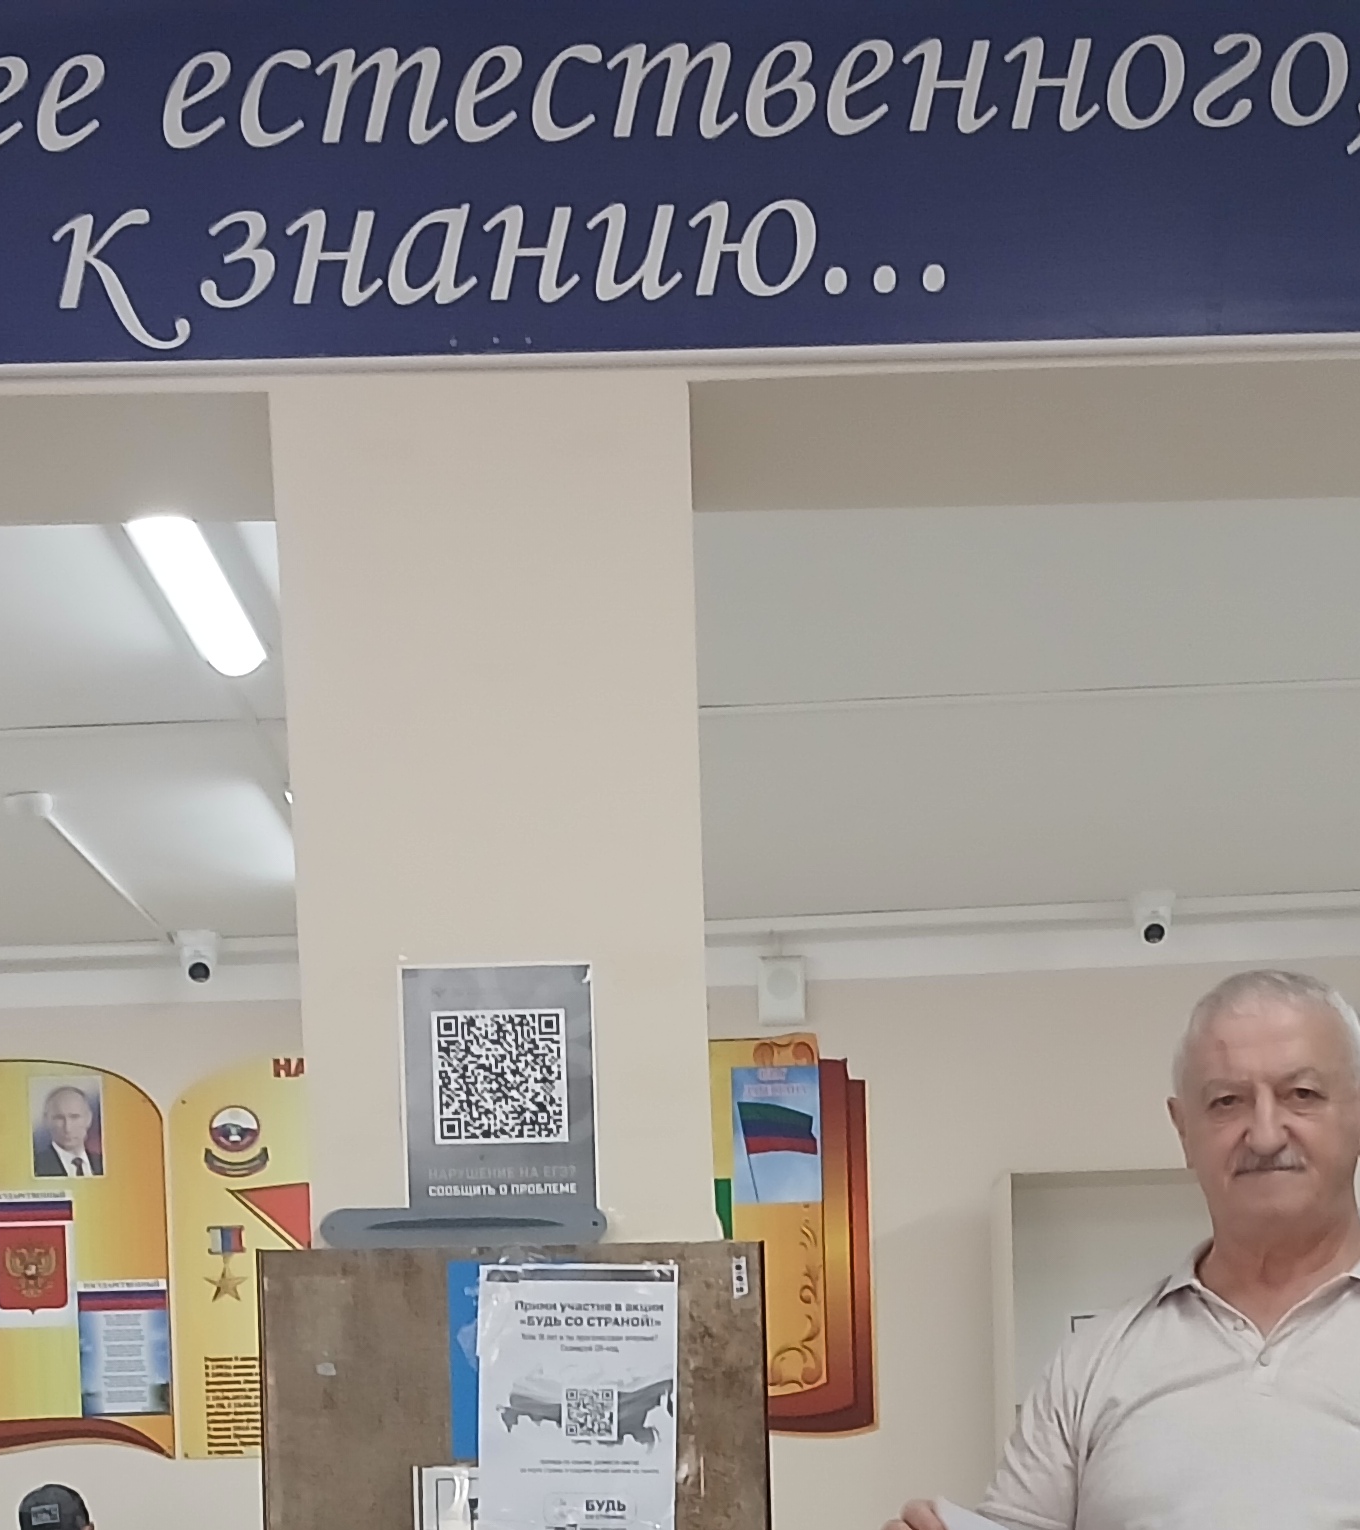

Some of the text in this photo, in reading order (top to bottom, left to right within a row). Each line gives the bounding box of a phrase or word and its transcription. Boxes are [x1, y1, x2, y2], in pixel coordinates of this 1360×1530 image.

[51, 206, 191, 350] к
[428, 1182, 578, 1197] СООБЩИТЬ О ПРОБЛЕМЕ
[564, 1316, 584, 1328] СО
[585, 1499, 627, 1513] БУДЬ
